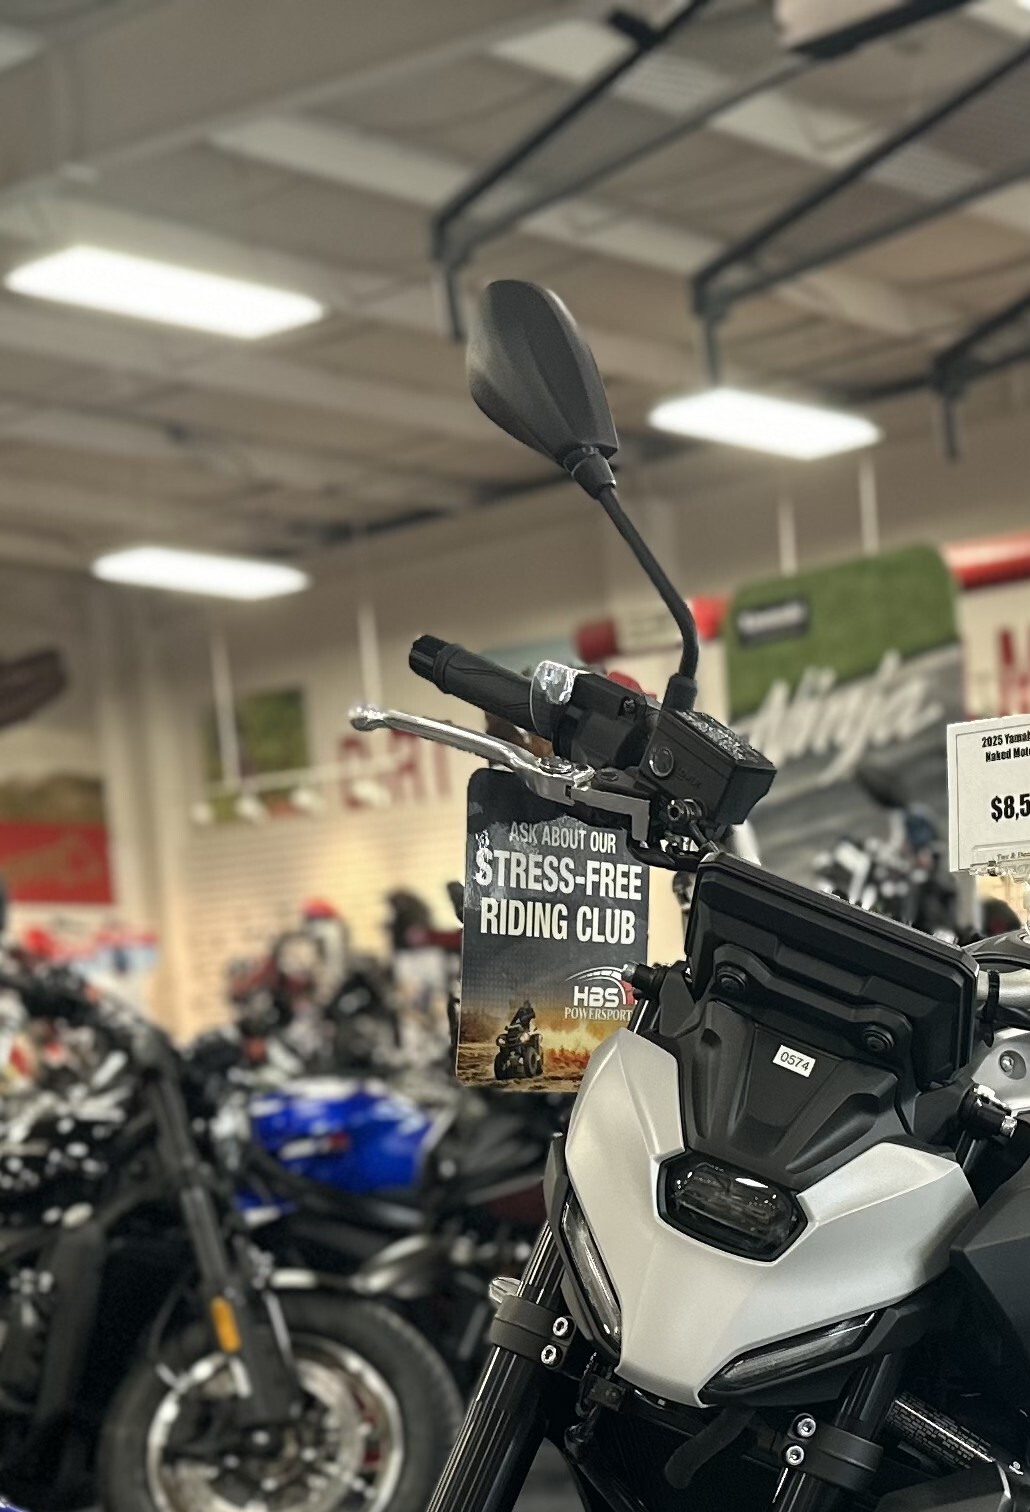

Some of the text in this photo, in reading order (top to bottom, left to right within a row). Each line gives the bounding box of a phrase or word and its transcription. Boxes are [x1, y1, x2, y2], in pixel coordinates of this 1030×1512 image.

[981, 734, 1004, 748] 2025
[985, 748, 1011, 763] Naked
[508, 821, 617, 855] ASK ABOUT OUR
[475, 847, 642, 901] STRESS-FREE
[480, 896, 636, 945] RIDING CLUB
[573, 985, 620, 1008] HBS
[780, 1051, 810, 1072] 0574
